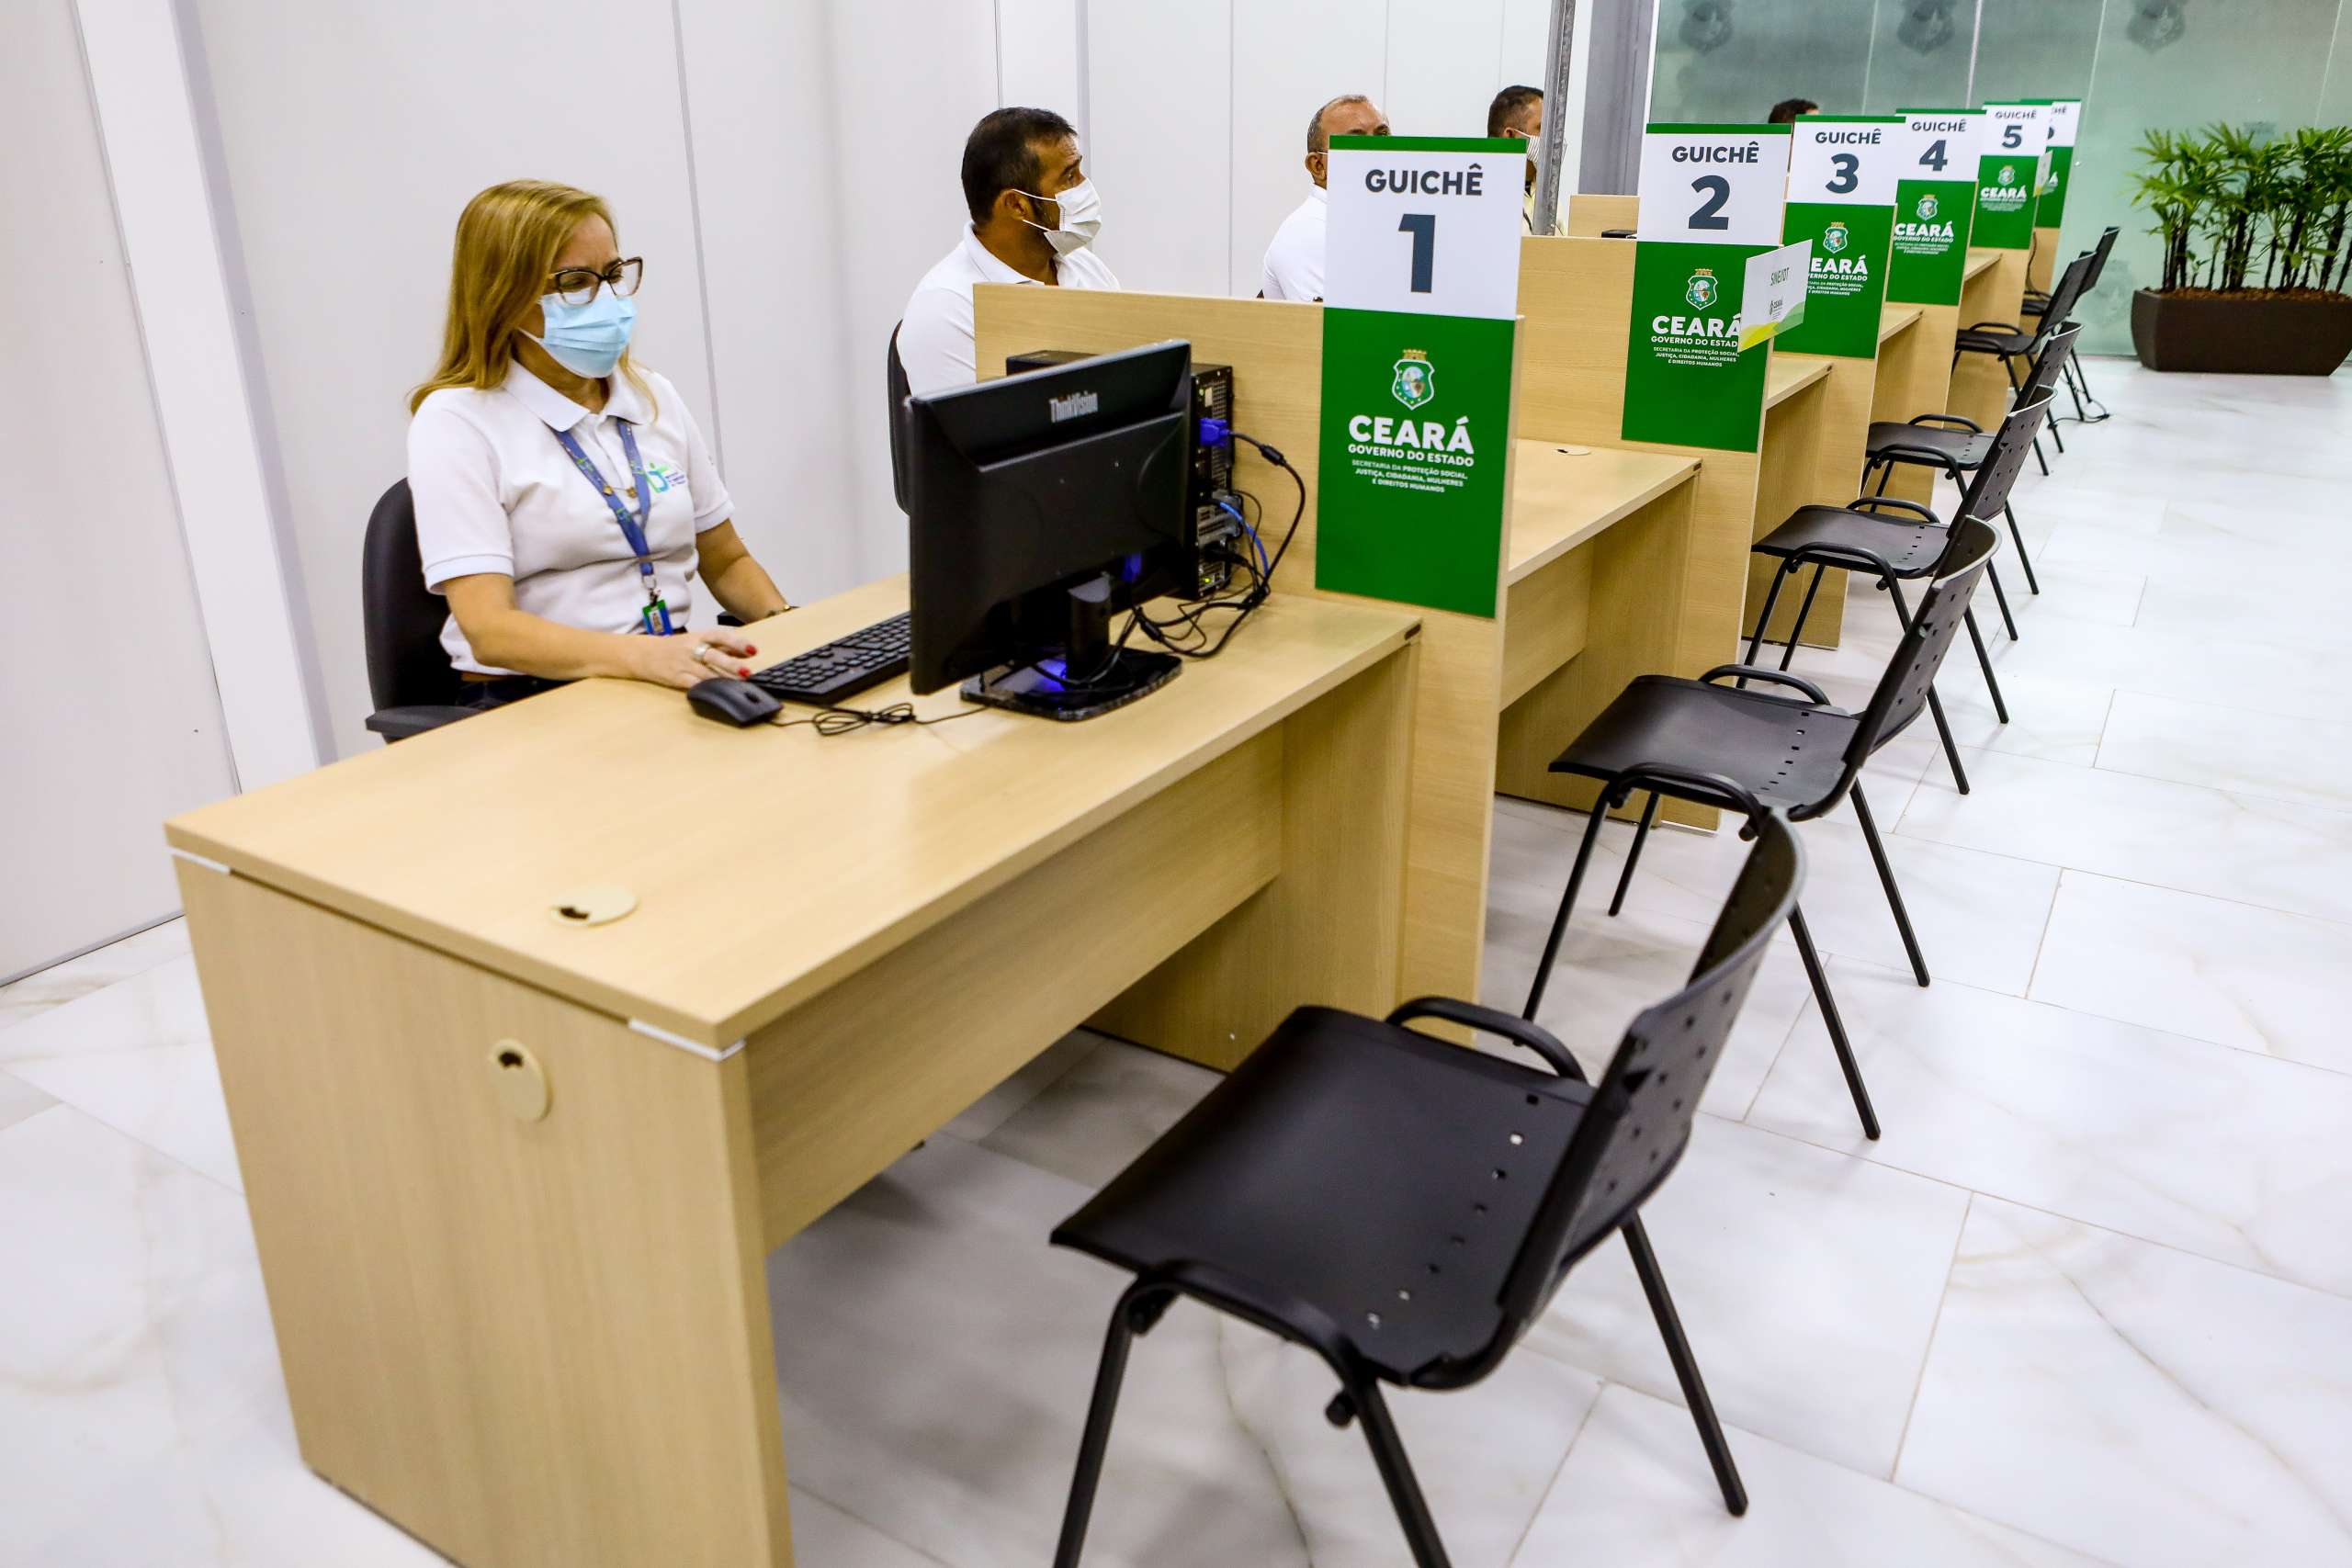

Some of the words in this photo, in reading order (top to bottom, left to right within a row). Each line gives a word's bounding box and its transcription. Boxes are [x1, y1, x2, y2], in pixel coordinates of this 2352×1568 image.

[1912, 118, 1966, 132] GUICHÊ
[1995, 110, 2037, 119] GUICHÊ
[1815, 128, 1882, 144] GUICHÊ
[2002, 125, 2022, 148] 5
[1672, 141, 1759, 163] GUICHÊ
[1919, 140, 1948, 171] 4
[1365, 163, 1484, 196] GUICHÊ
[1825, 153, 1859, 194] 3
[1688, 175, 1730, 230] 2
[1980, 185, 2027, 199] CEARÁ
[1894, 221, 1954, 237] CEARÁ
[1398, 214, 1436, 293] 1
[1810, 254, 1868, 275] EARÁ
[1652, 313, 1741, 338] CEARÁ
[1651, 336, 1693, 345] GOVERNO
[1048, 390, 1098, 423] ThinkVision
[1348, 415, 1474, 454] CEARÁ
[1348, 444, 1404, 459] GOVERNO
[1407, 451, 1425, 461] DO
[1427, 453, 1474, 467] ESTADO
[1352, 459, 1391, 470] SECRETARIA
[1403, 465, 1440, 476] PROTEÇÃO
[1440, 469, 1468, 479] SOCIAL,
[1355, 468, 1385, 479] JUSTIÇA,
[1386, 472, 1426, 483] CIDADANIA,
[1427, 477, 1463, 487] MULHERES
[1378, 479, 1409, 488] DIREITOS
[1410, 484, 1445, 493] HUMANOS
